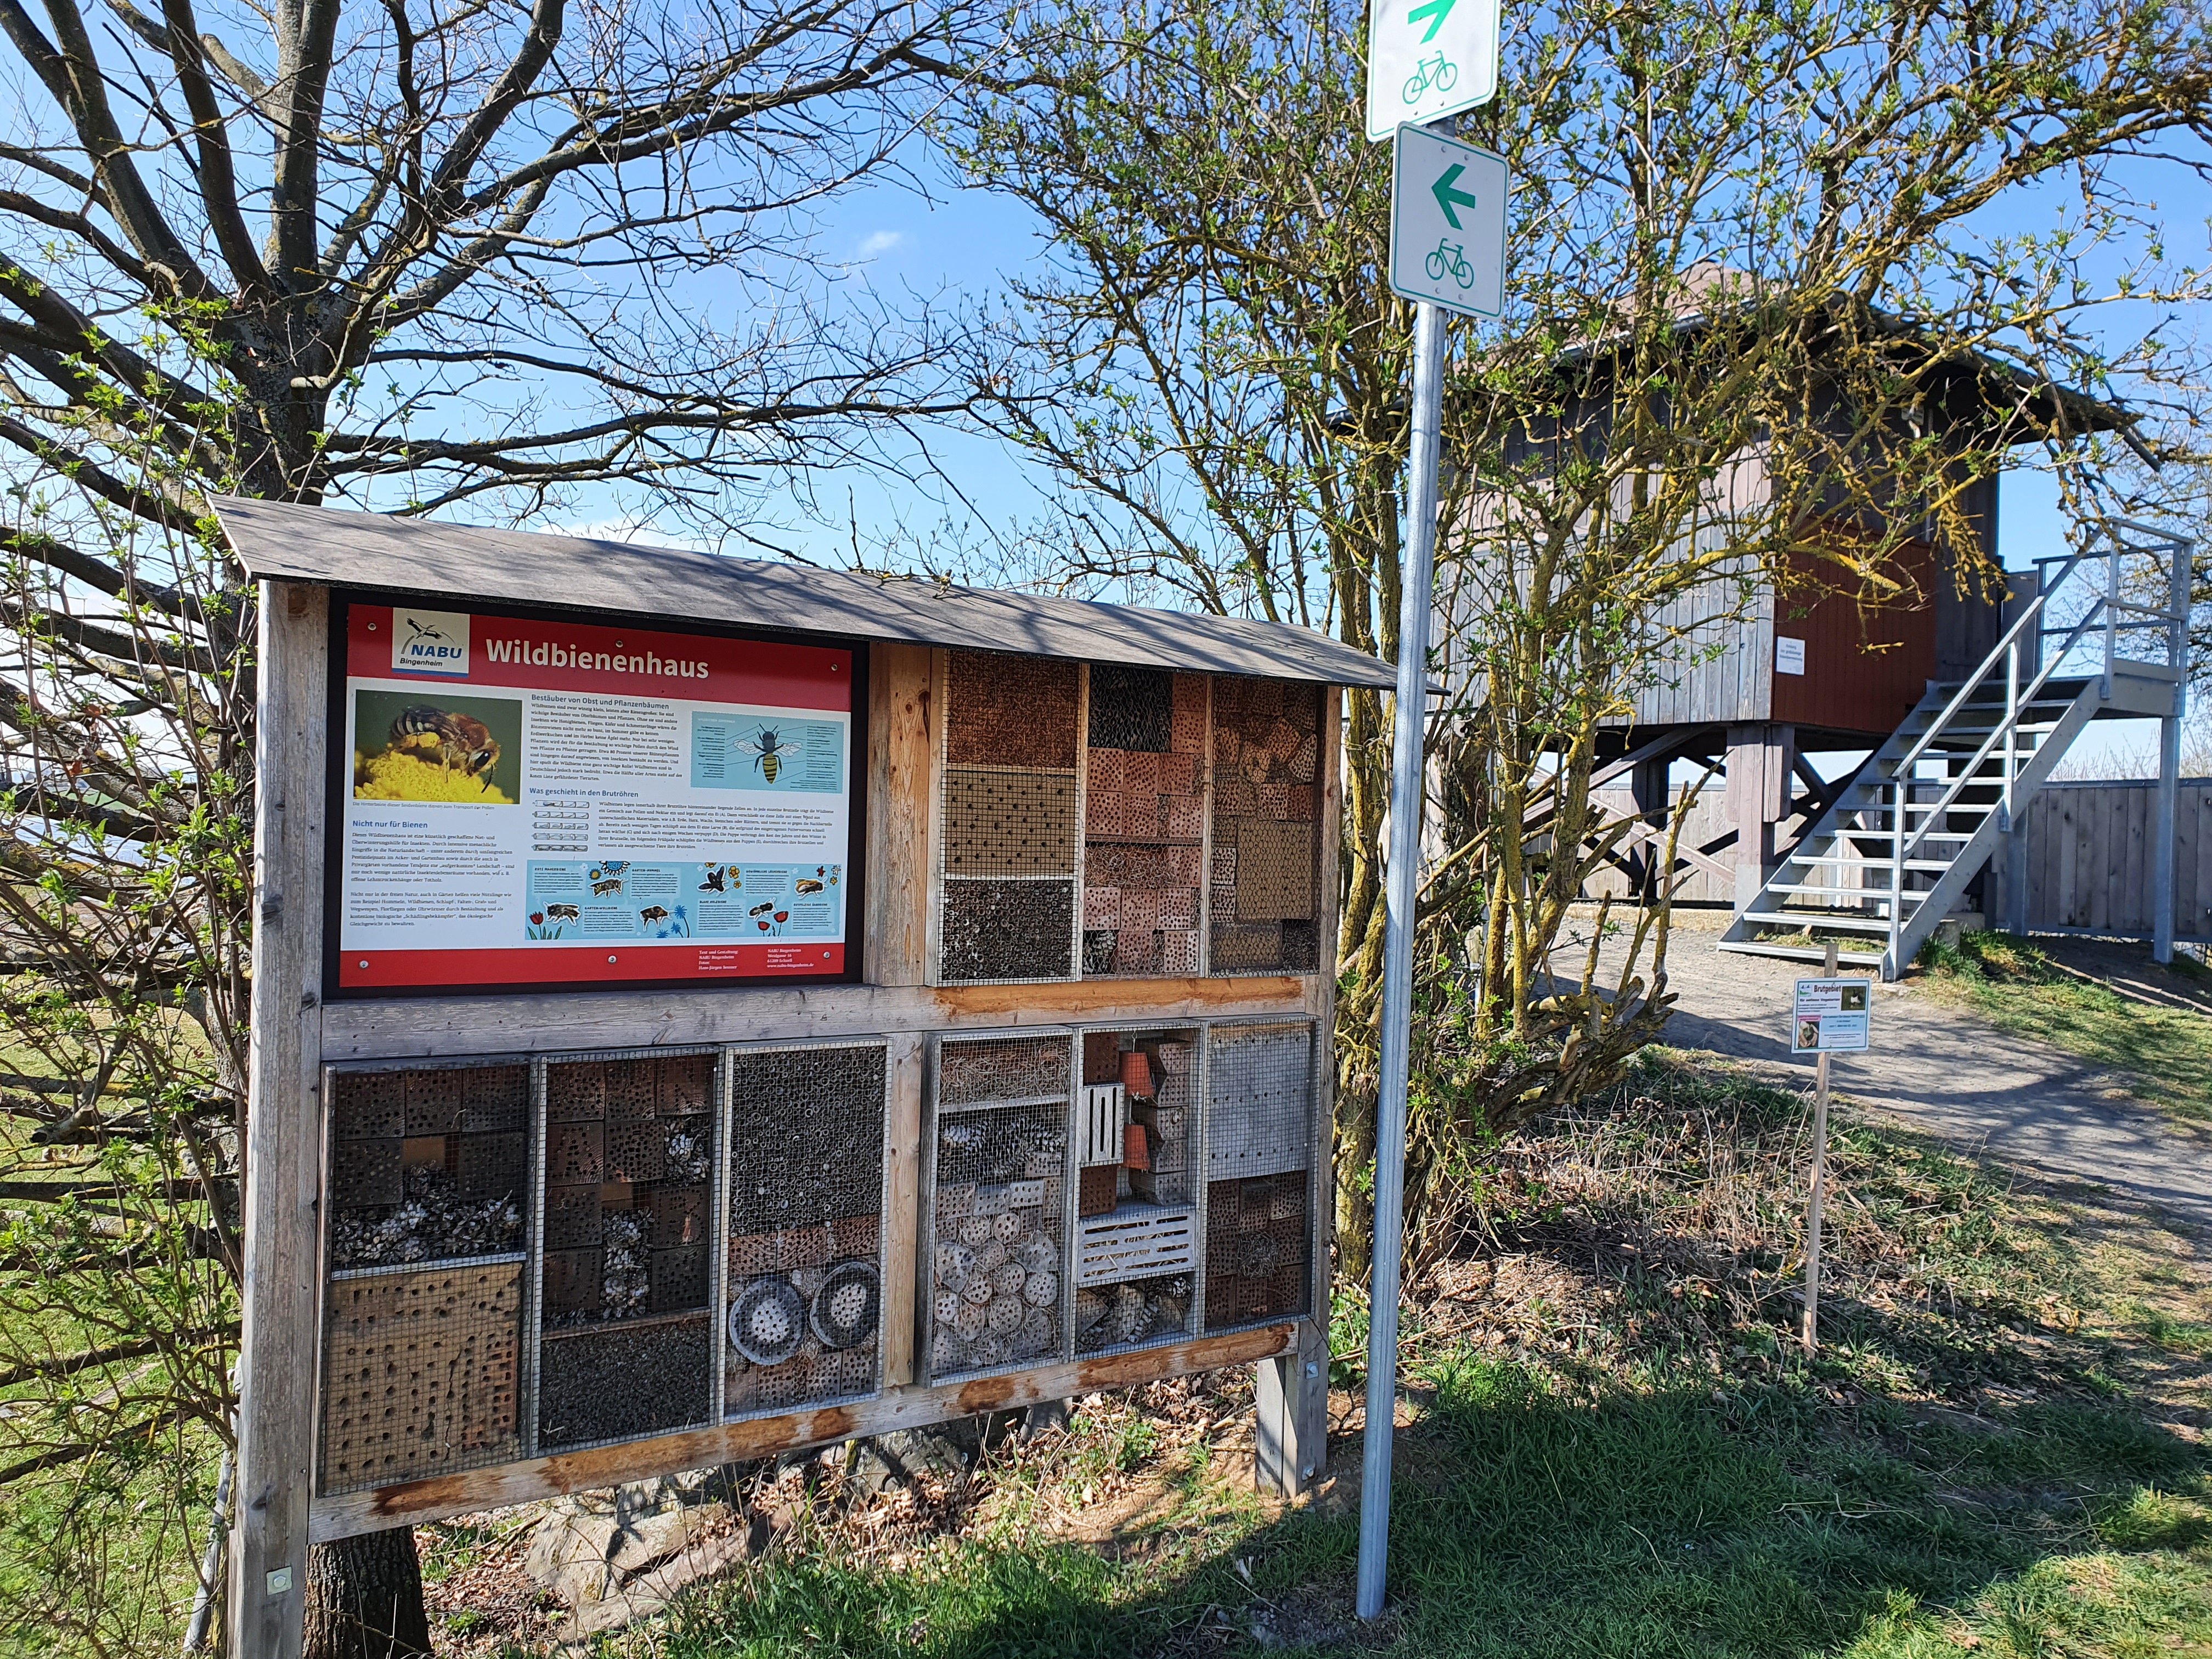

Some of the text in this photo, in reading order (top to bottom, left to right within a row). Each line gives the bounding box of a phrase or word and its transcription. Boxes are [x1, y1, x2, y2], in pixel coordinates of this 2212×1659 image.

[411, 644, 462, 658] NABU
[400, 657, 443, 667] Bingenheim
[486, 639, 709, 679] Wildbienenhaus
[532, 693, 567, 702] Bestäuber
[614, 699, 669, 709] Pflanzenbäumen
[1814, 985, 1841, 994] Brutgebiet
